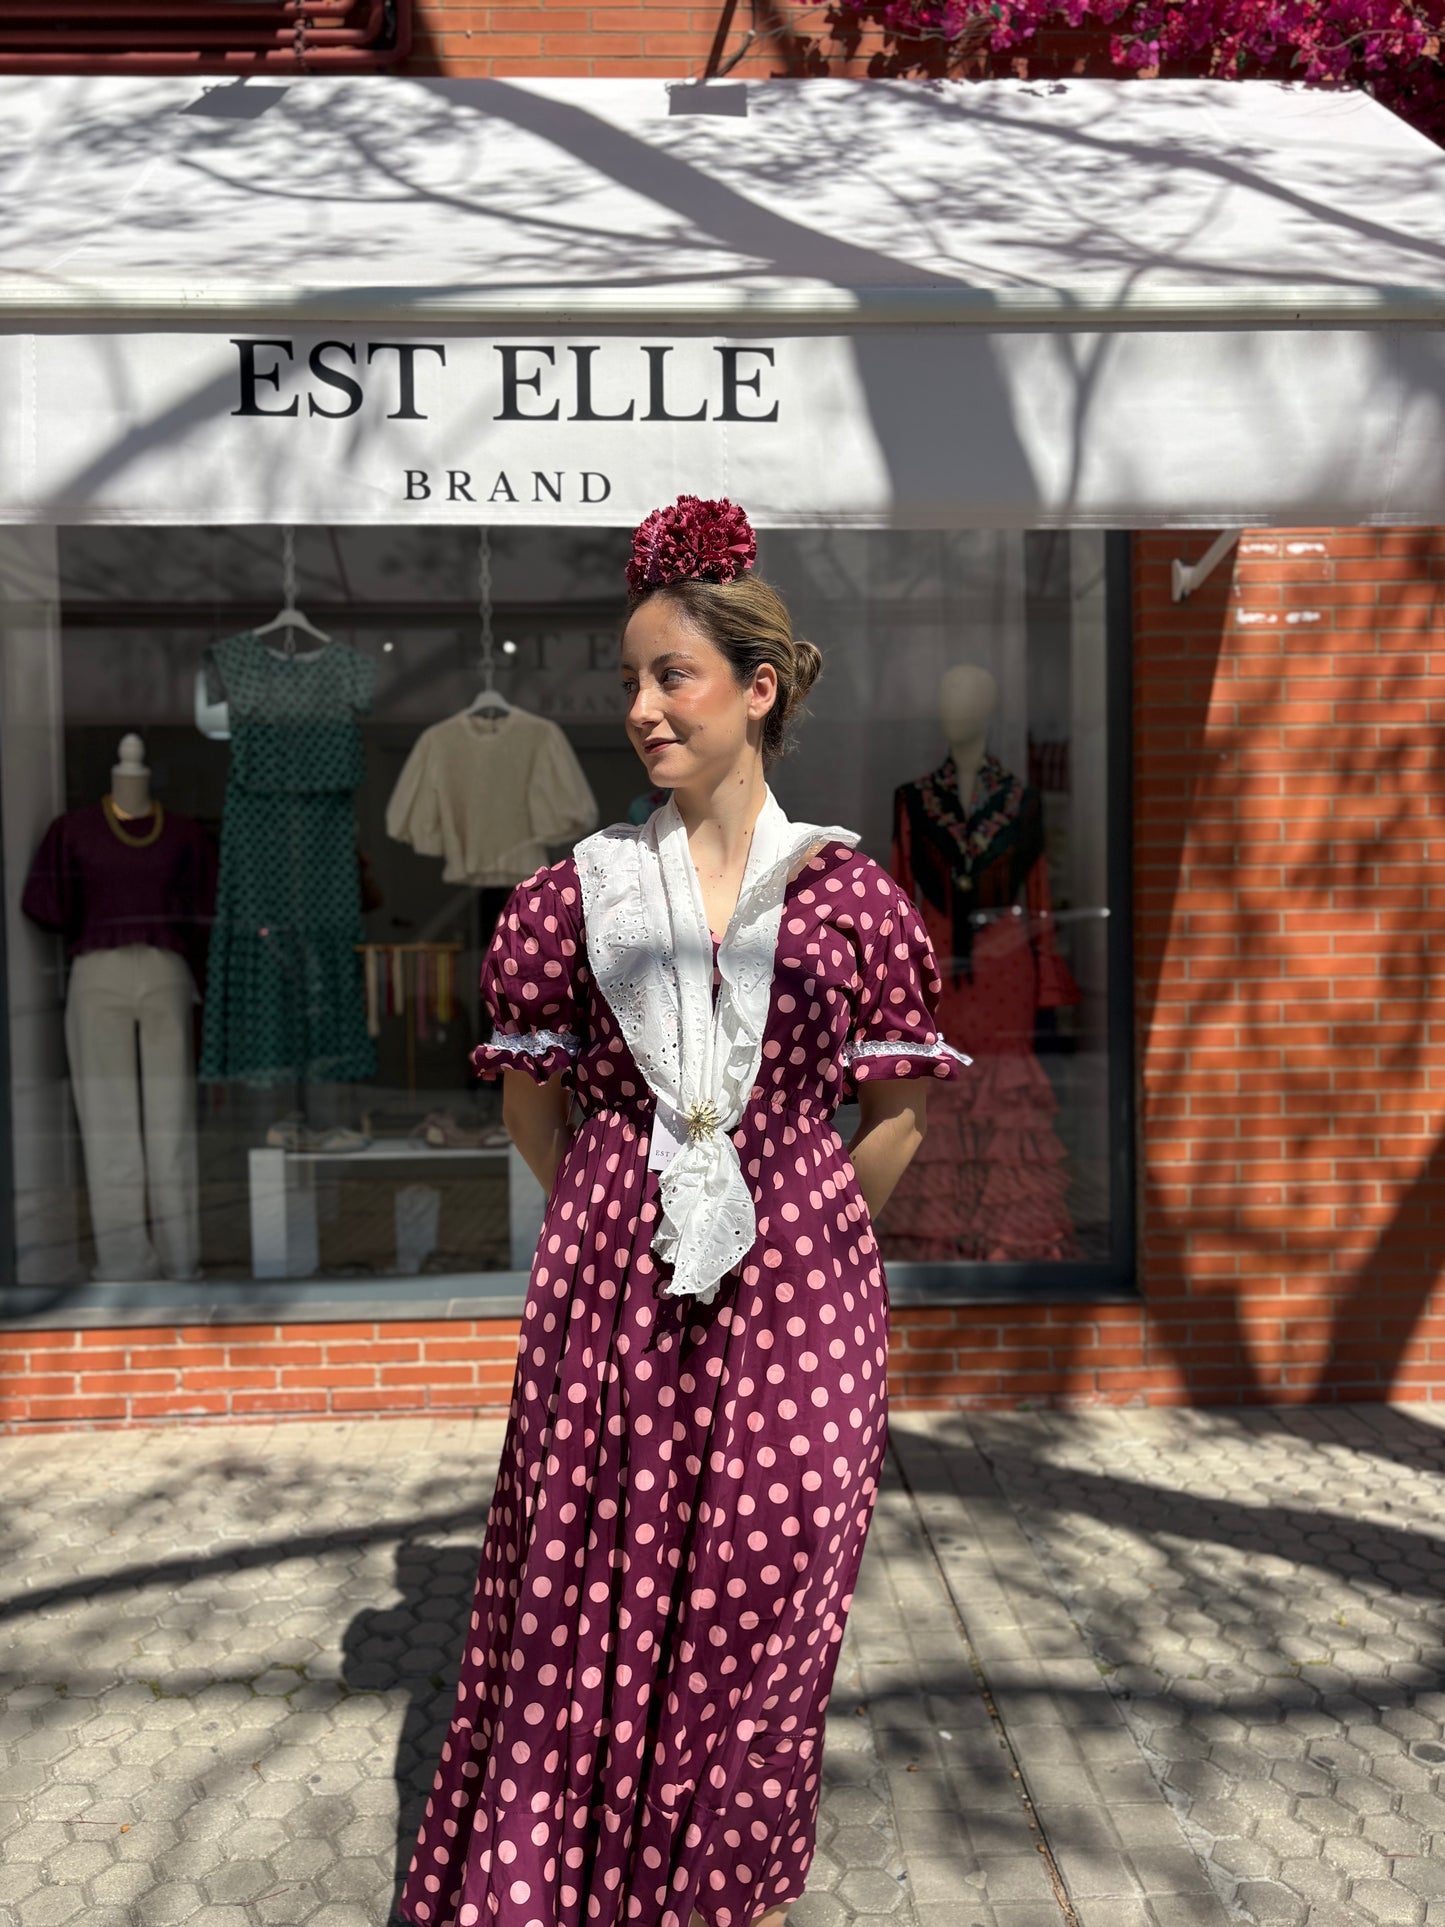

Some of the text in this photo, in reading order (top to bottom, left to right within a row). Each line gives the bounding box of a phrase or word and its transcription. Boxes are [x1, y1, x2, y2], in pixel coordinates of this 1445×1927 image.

[230, 338, 779, 422] EST ELLE
[404, 469, 611, 503] BRAND
